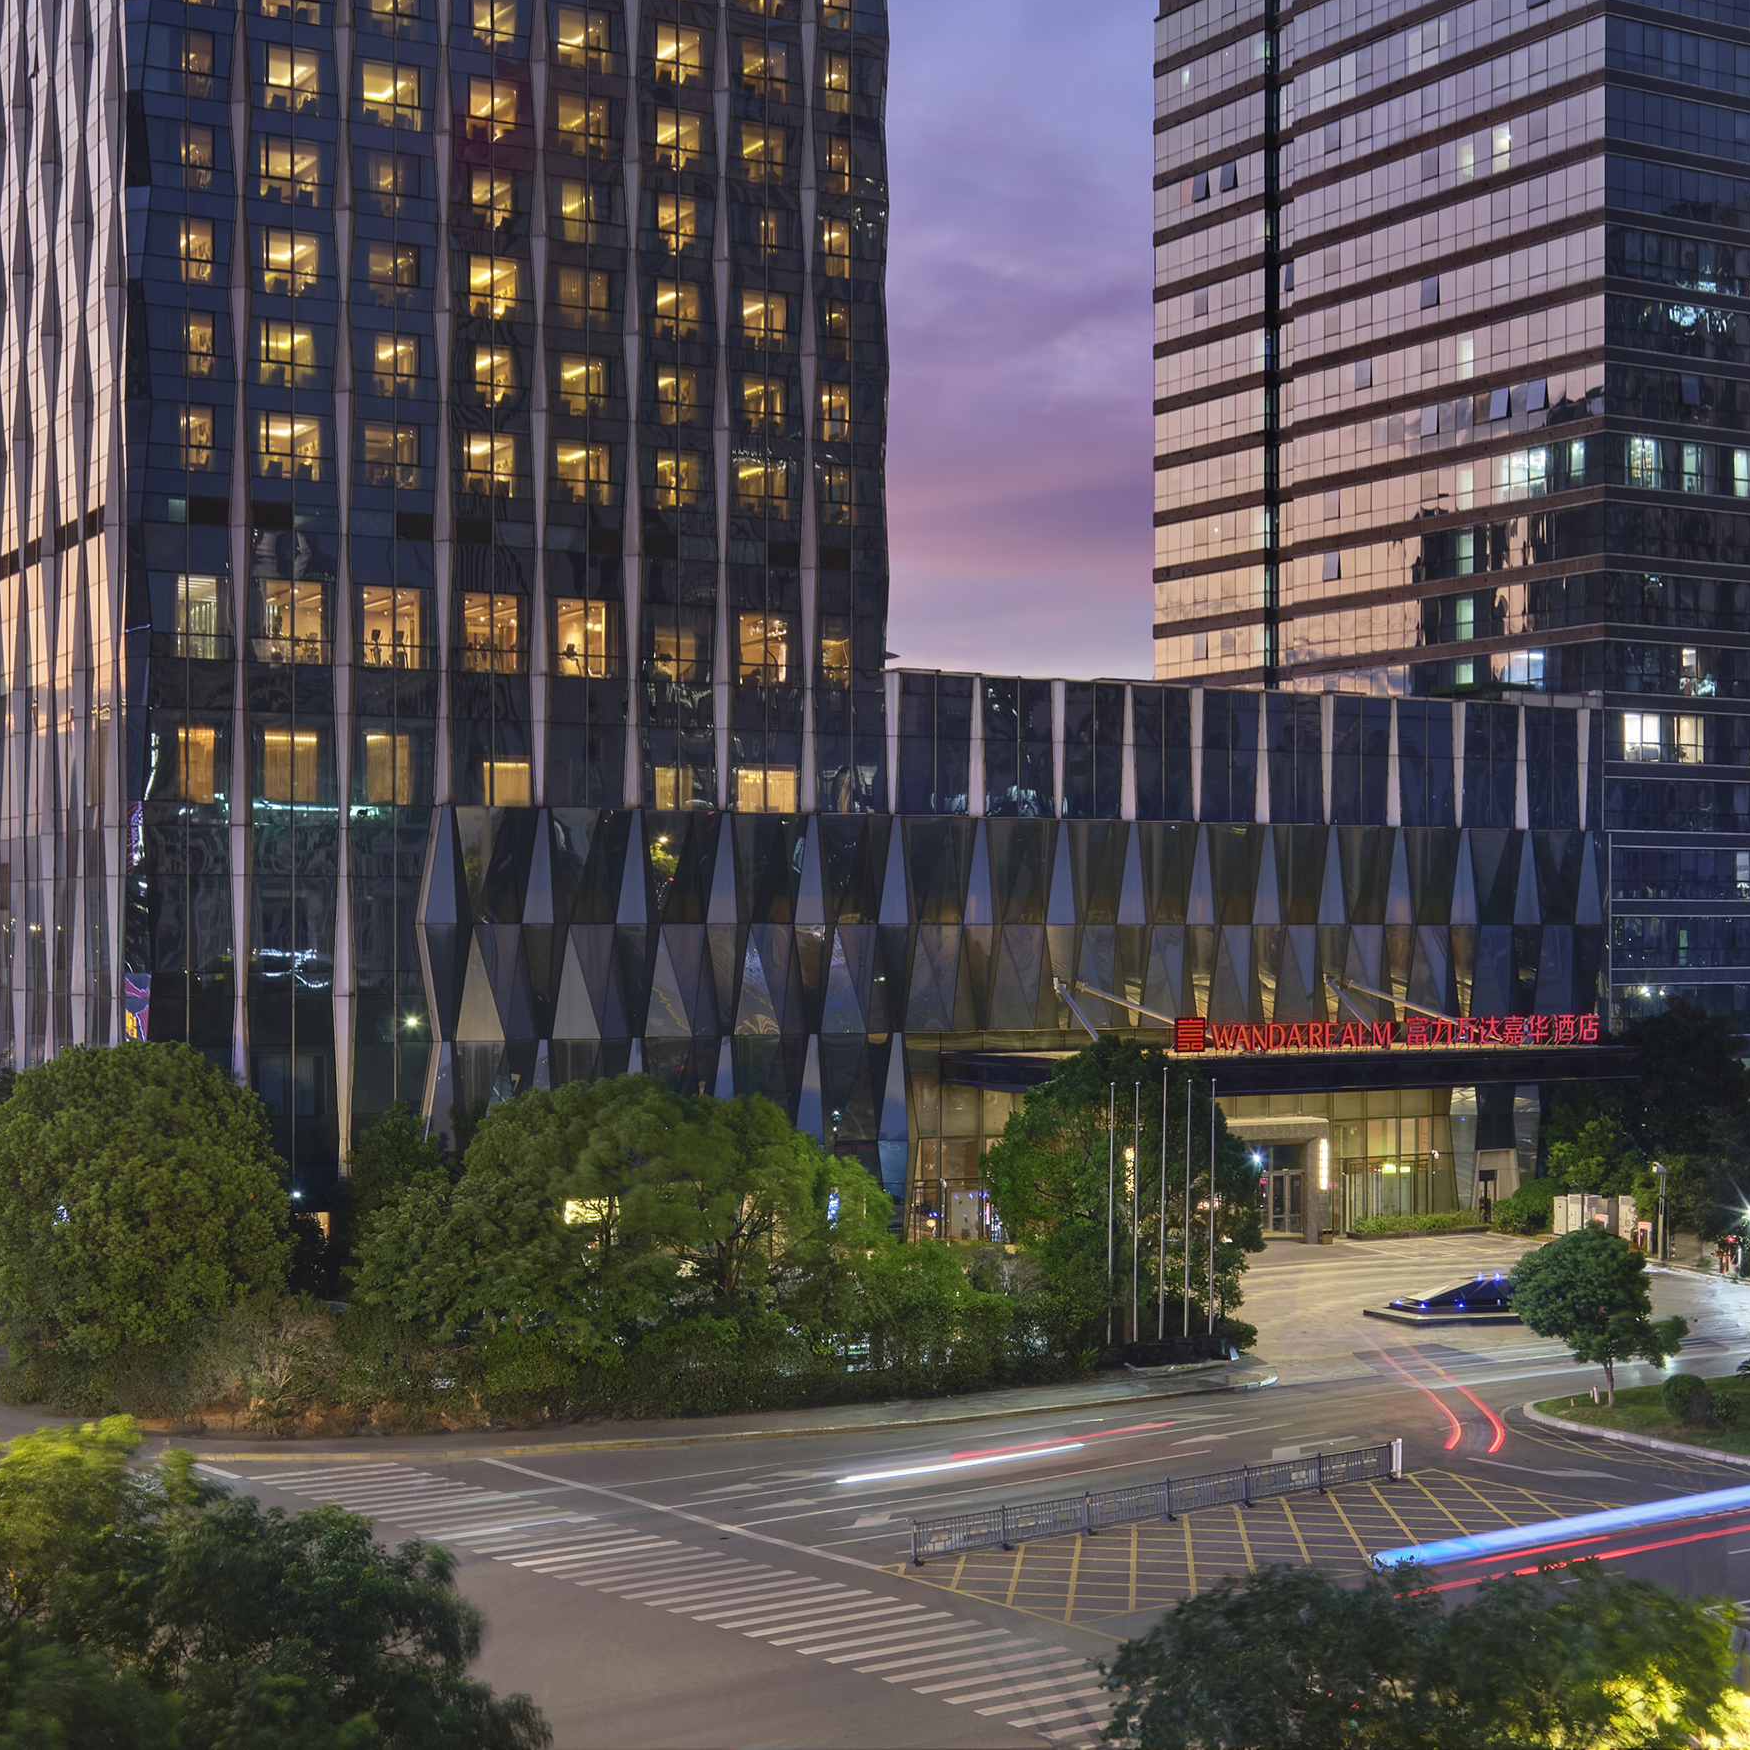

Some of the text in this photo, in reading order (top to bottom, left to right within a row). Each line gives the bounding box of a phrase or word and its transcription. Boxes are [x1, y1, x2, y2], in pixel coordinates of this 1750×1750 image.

[1211, 1021, 1391, 1050] WANDA REALM
[1406, 1013, 1600, 1046] 富力万达嘉华酒店
